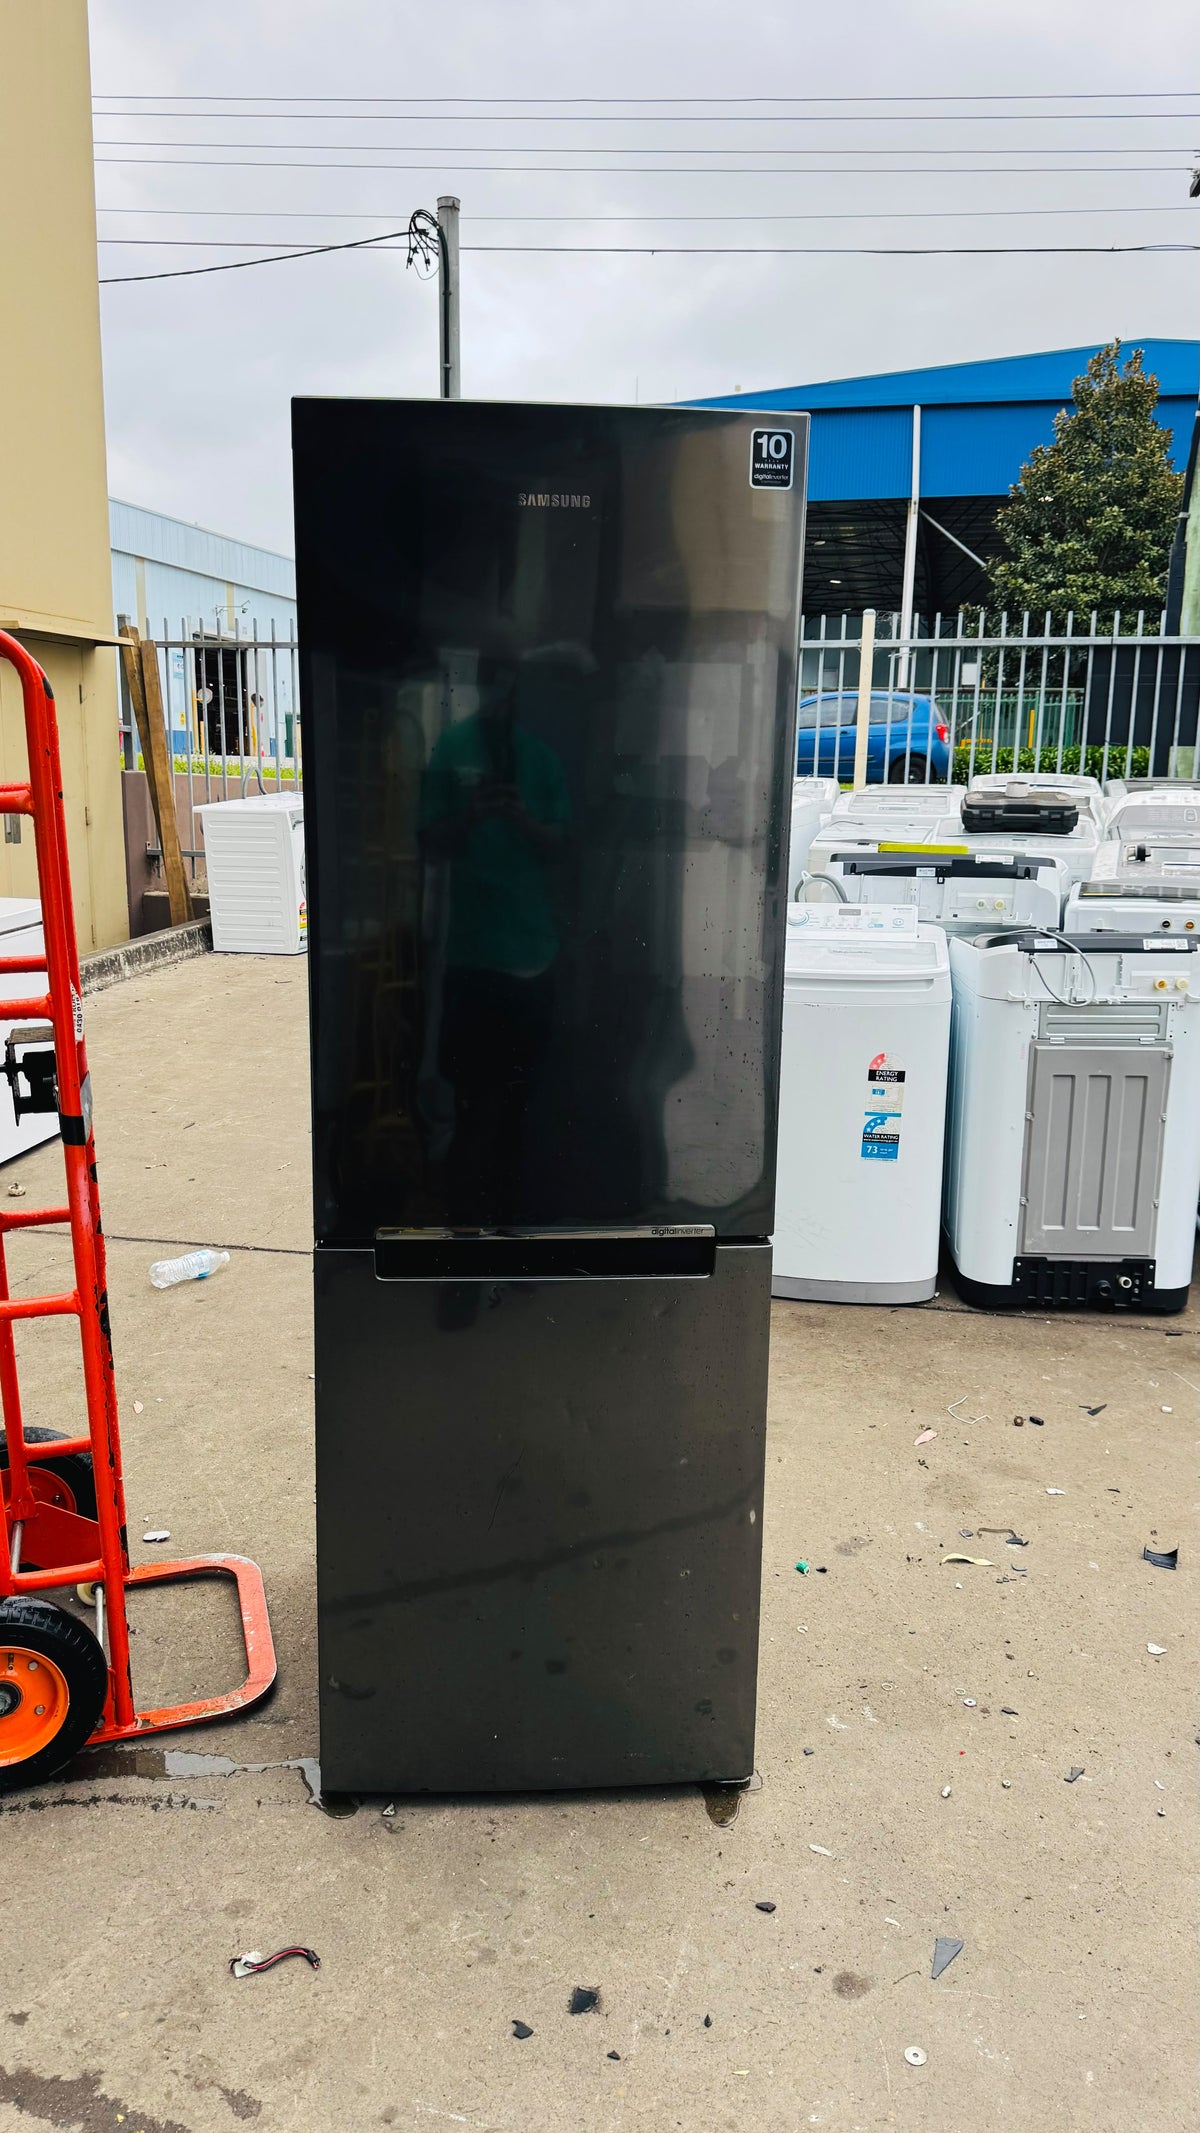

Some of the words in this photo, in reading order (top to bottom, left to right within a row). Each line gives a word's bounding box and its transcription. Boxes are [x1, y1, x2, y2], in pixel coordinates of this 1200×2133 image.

[757, 434, 787, 459] 10
[518, 493, 591, 508] SAMSUNG
[866, 1145, 878, 1154] 73
